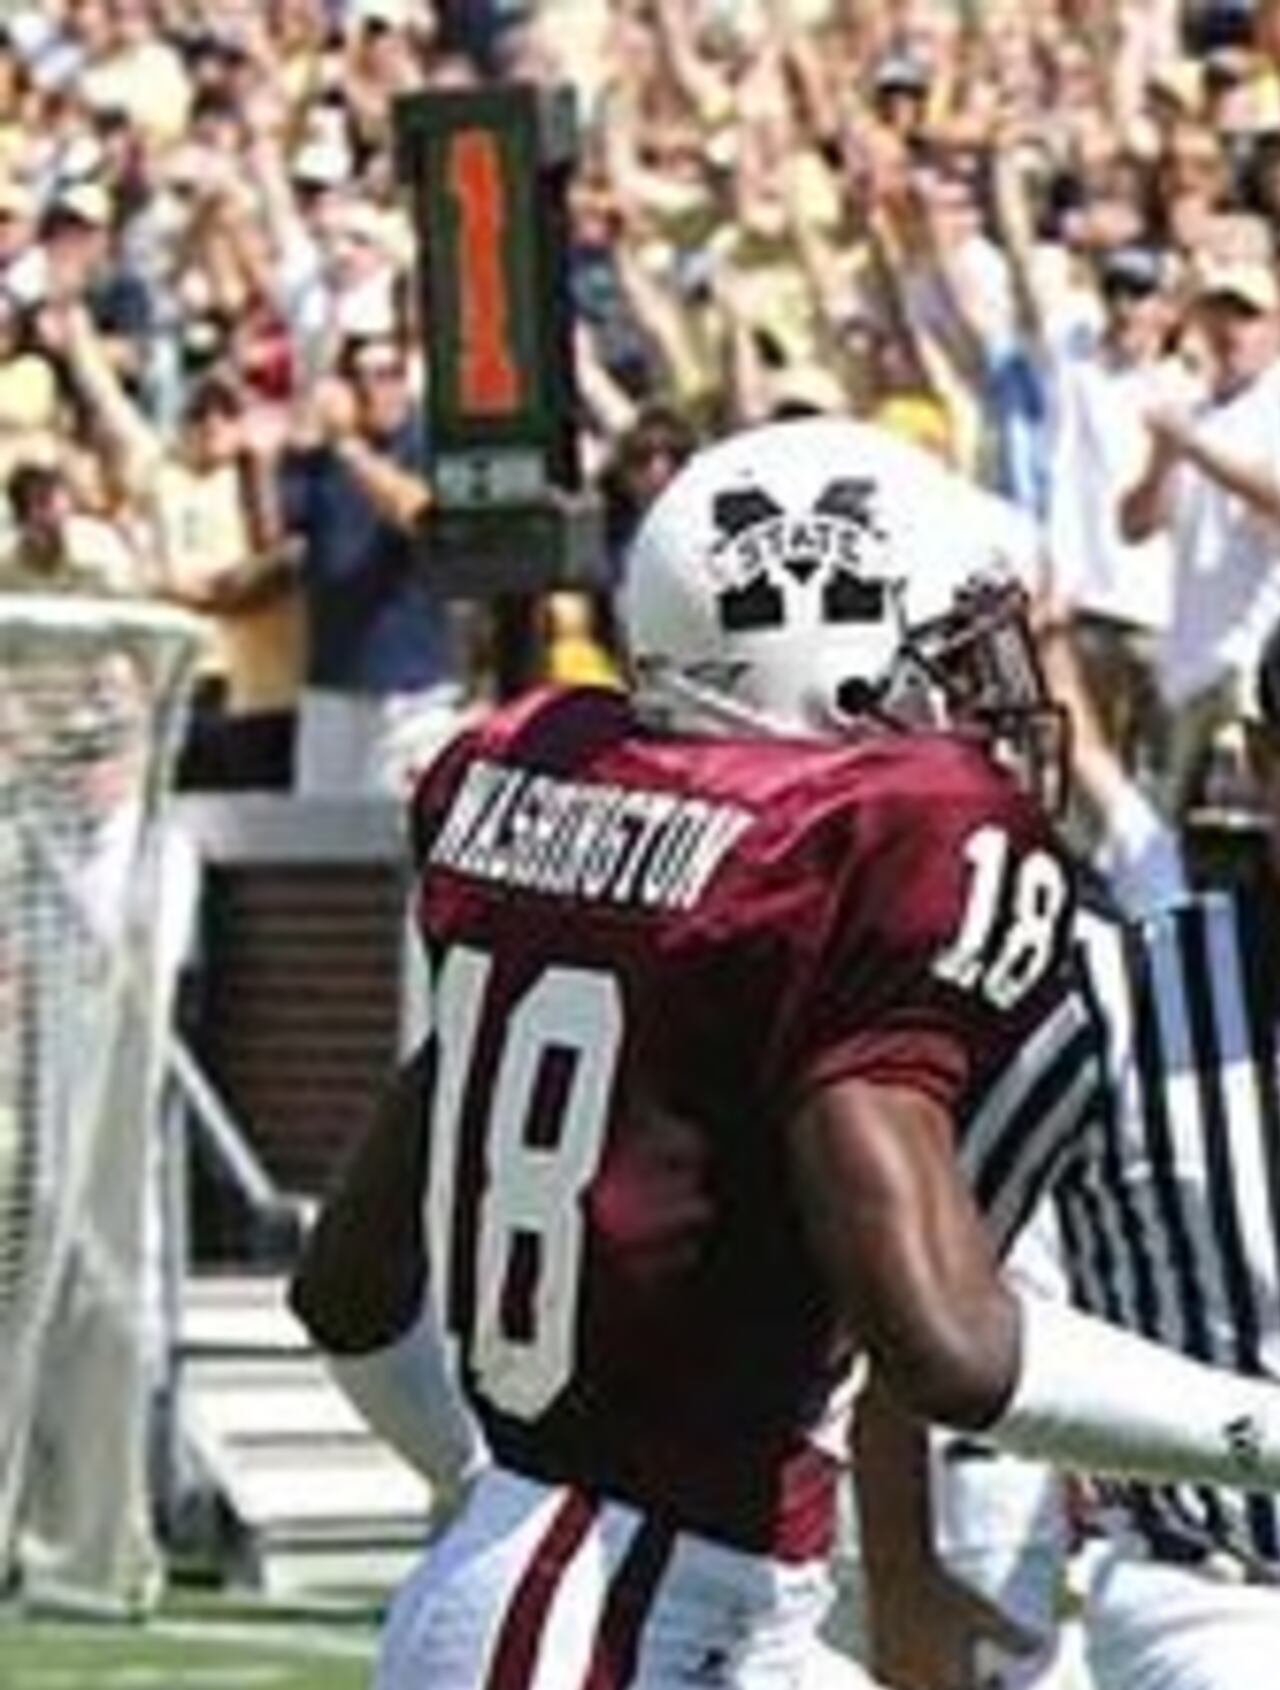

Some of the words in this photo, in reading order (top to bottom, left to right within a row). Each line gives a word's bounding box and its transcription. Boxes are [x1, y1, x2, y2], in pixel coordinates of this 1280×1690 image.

[452, 126, 525, 416] 1
[428, 758, 756, 910] WASHINGTON
[930, 822, 1068, 1010] 18
[423, 943, 624, 1424] 18
